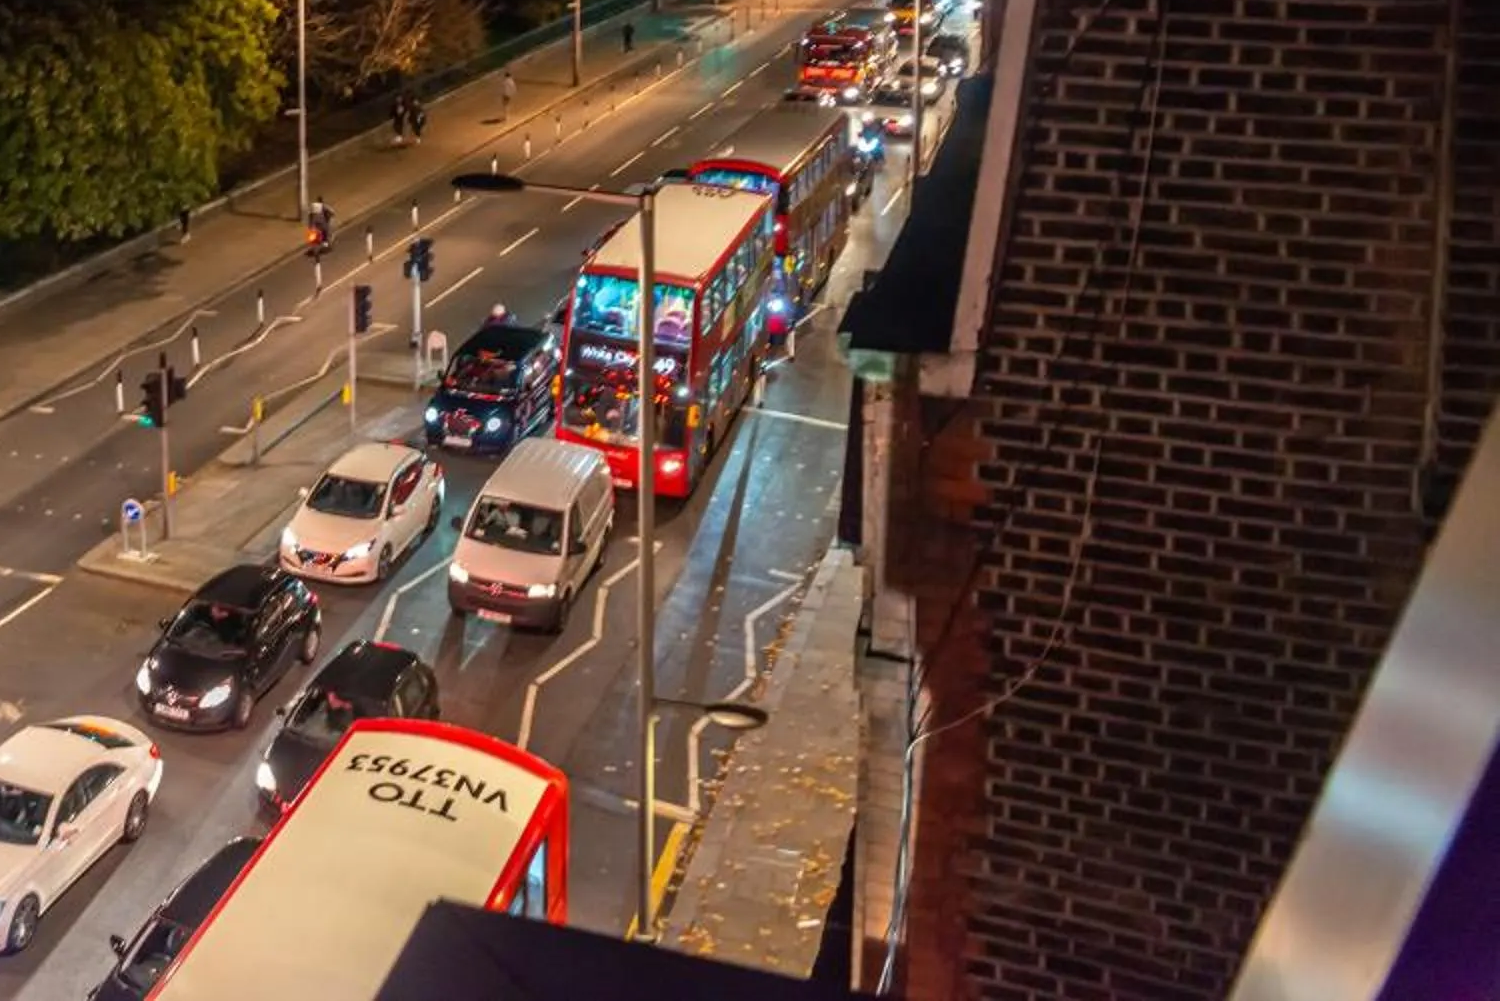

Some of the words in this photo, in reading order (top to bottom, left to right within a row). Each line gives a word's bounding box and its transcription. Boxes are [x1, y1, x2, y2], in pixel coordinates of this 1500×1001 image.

[652, 358, 676, 375] 49
[347, 754, 508, 812] VN37953
[368, 782, 458, 822] TTO
